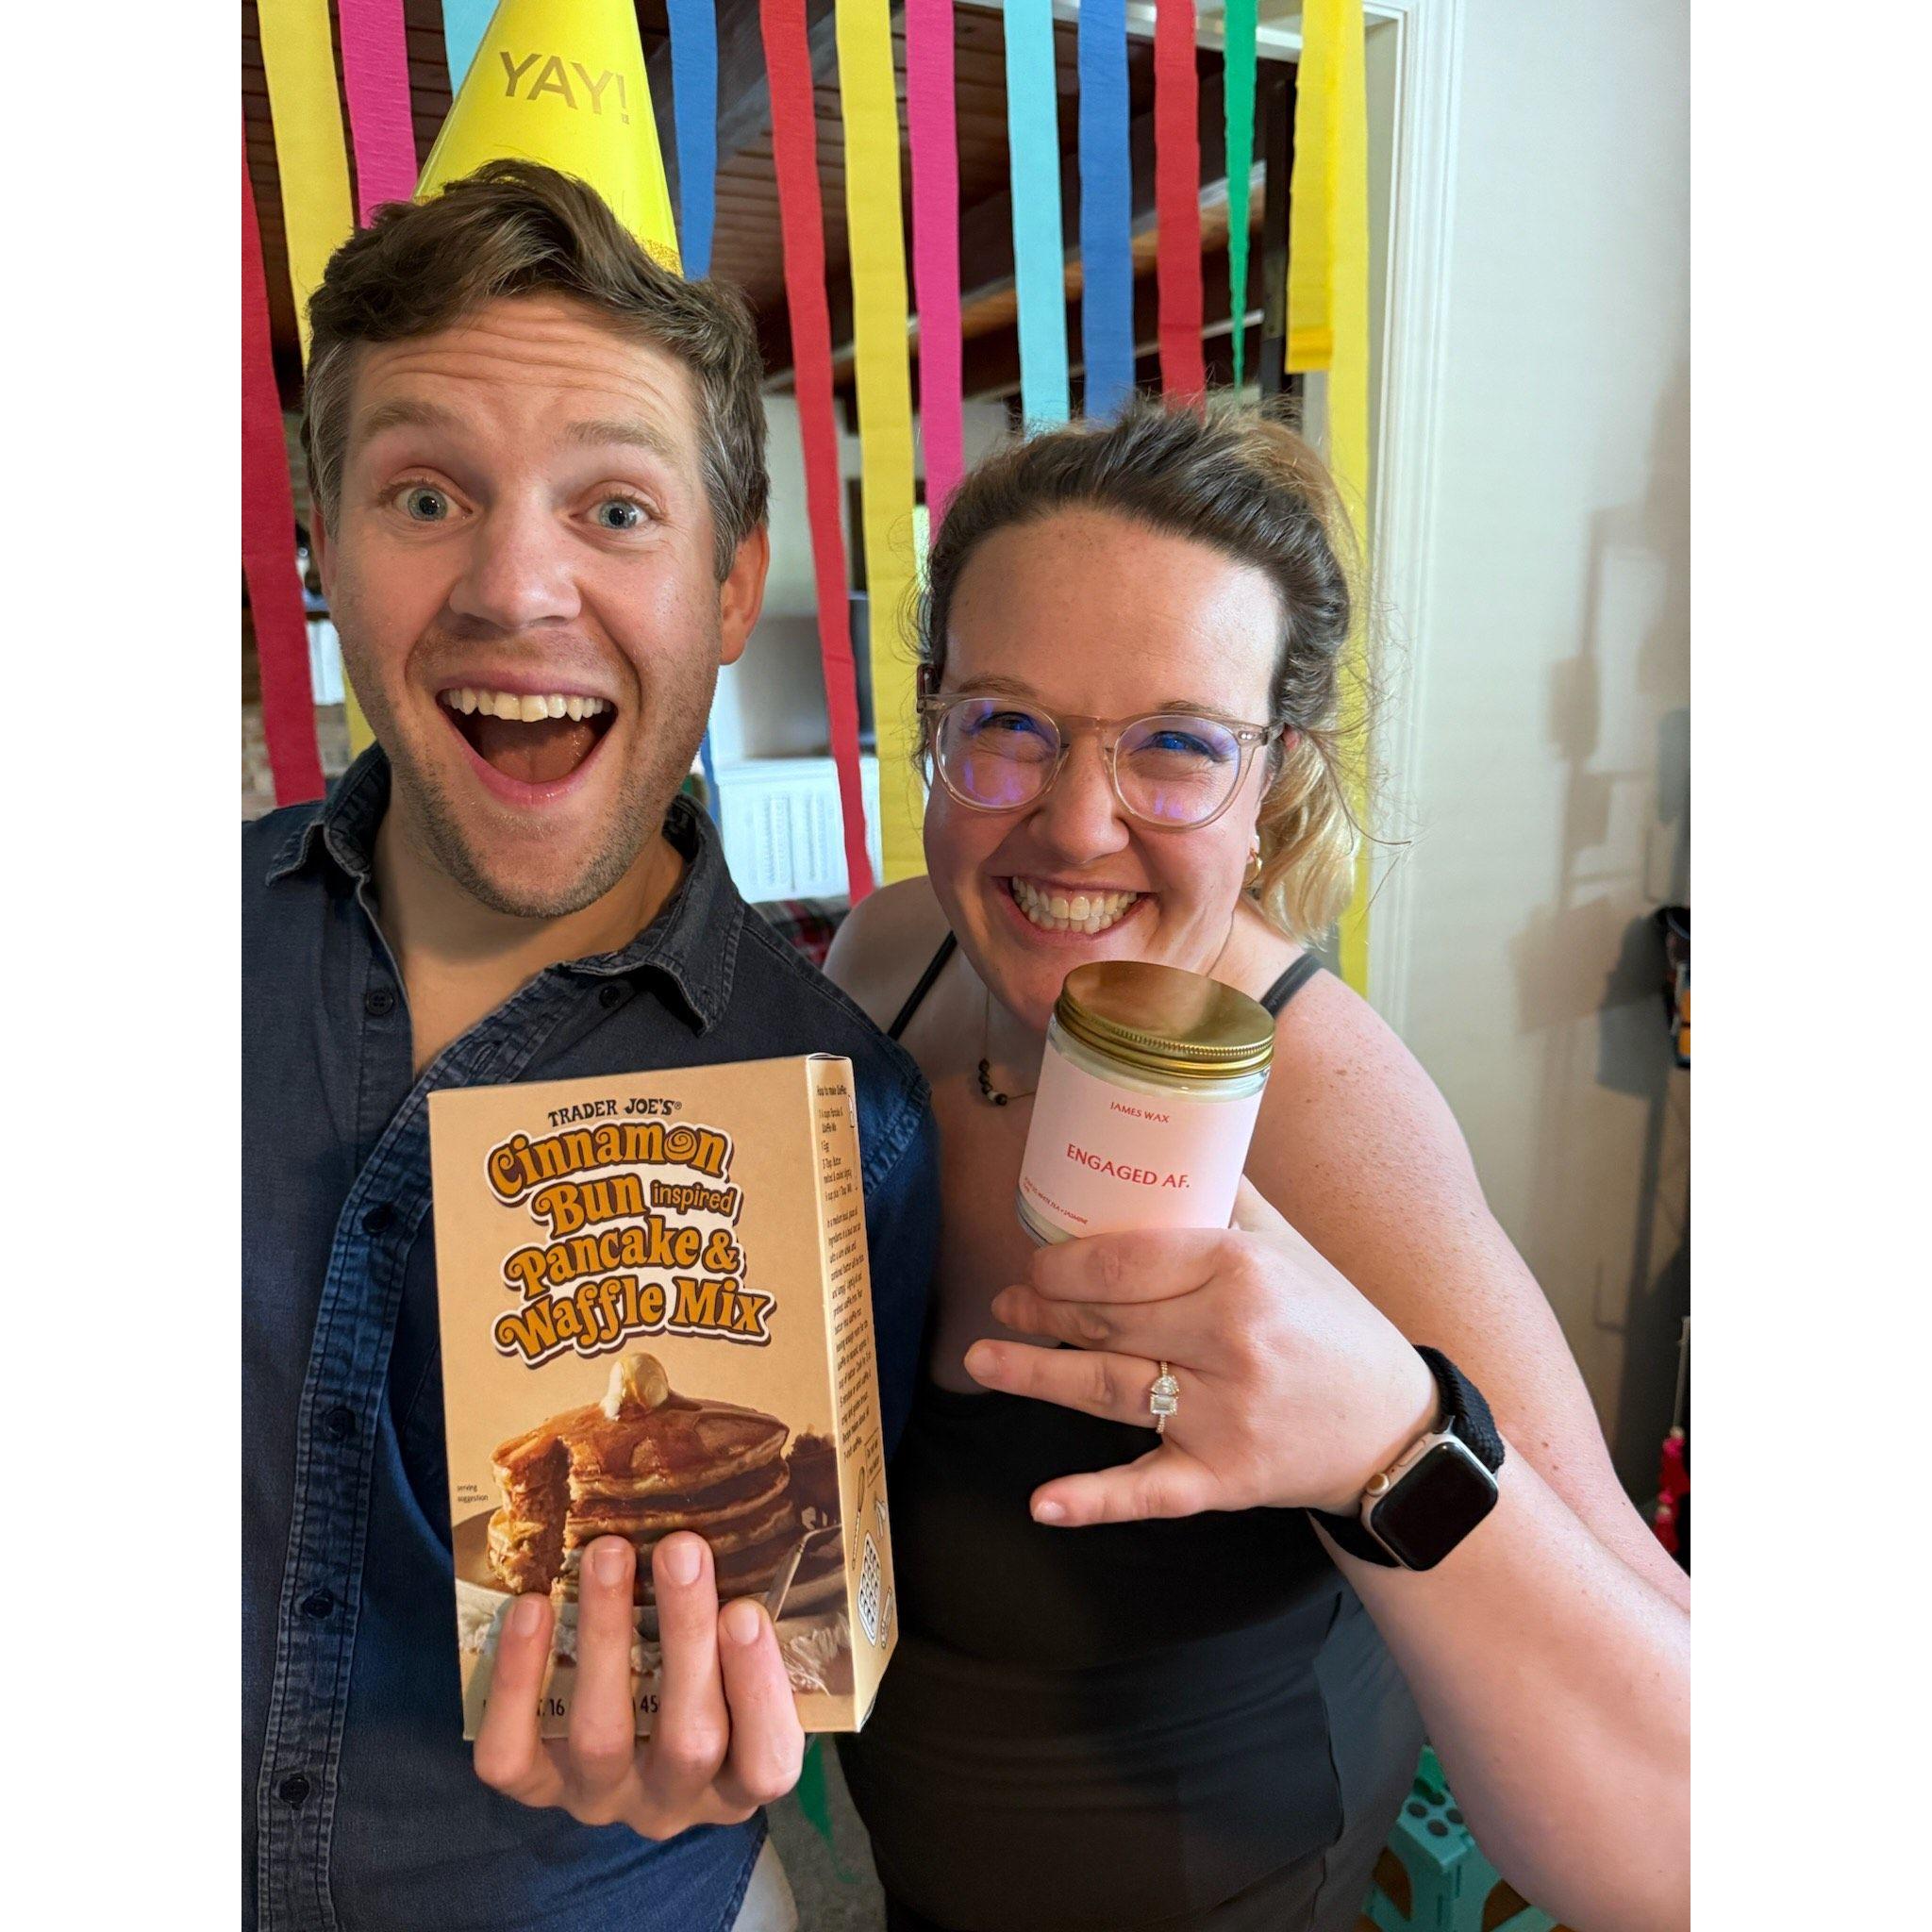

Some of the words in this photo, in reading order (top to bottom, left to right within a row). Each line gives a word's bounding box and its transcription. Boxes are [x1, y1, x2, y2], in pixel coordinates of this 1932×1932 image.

[499, 51, 630, 125] YAY!
[547, 1098, 618, 1127] TRADER
[1109, 1101, 1142, 1118] JAMES
[1143, 1110, 1170, 1124] WAX
[487, 1121, 729, 1199] Cinnamon
[1066, 1142, 1158, 1186] ENGAGED
[1161, 1174, 1191, 1189] AF.
[532, 1174, 650, 1240] Bun
[650, 1180, 736, 1214] inspired
[505, 1215, 701, 1300] Pancake
[702, 1229, 741, 1273] &
[494, 1274, 666, 1360] Waffle
[668, 1275, 771, 1337] Mix
[458, 1484, 476, 1492] serving
[458, 1493, 489, 1503] suggestion
[549, 1698, 566, 1716] 16
[640, 1695, 658, 1714] 45
